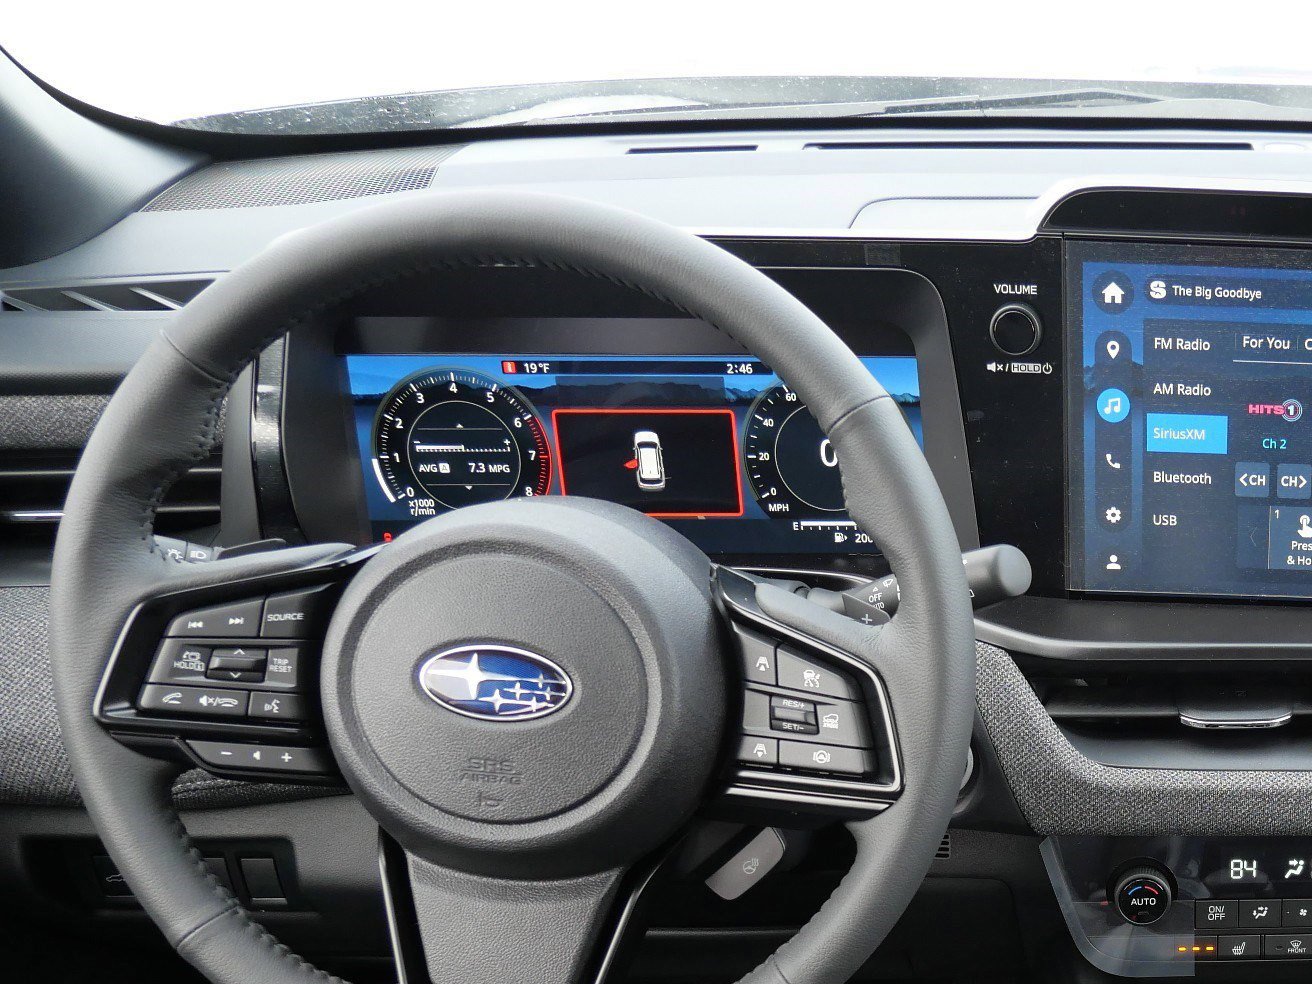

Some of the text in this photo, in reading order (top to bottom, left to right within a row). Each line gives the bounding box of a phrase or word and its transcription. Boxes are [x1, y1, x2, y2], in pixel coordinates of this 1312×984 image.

[994, 284, 1037, 294] VOLUME
[1172, 285, 1192, 296] The
[1195, 286, 1211, 299] Big
[1215, 287, 1262, 301] Goodbye
[1154, 338, 1210, 351] FM Radio
[1243, 336, 1290, 349] For You
[727, 364, 752, 374] 2:46
[1012, 364, 1040, 372] HOLD
[450, 383, 457, 393] 4
[1154, 383, 1211, 396] AM Radio
[417, 393, 424, 403] 3
[487, 393, 494, 402] 5
[786, 393, 796, 401] 60
[1248, 404, 1285, 414] HITS
[395, 418, 403, 428] 2
[514, 418, 522, 427] 6
[763, 419, 773, 427] 40
[1154, 427, 1206, 440] SiriusXM
[1262, 439, 1287, 449] Ch 2
[394, 453, 400, 462] 1
[528, 450, 536, 460] 7
[759, 452, 769, 461] 20
[468, 463, 485, 473] 7.3
[489, 465, 510, 473] MPG
[1153, 471, 1211, 484] Bluetooth
[406, 487, 414, 497] 0
[525, 487, 533, 496] 8
[411, 507, 435, 516] r/min
[769, 504, 789, 512] MPH
[1275, 509, 1280, 519] 1
[1153, 515, 1177, 526] USB
[793, 522, 798, 530] E
[1287, 556, 1295, 565] &
[869, 593, 882, 603] OFF
[267, 613, 304, 622] SOURCE
[1230, 860, 1256, 879] 84
[1131, 898, 1156, 906] AUTO
[1208, 913, 1225, 921] OFF
